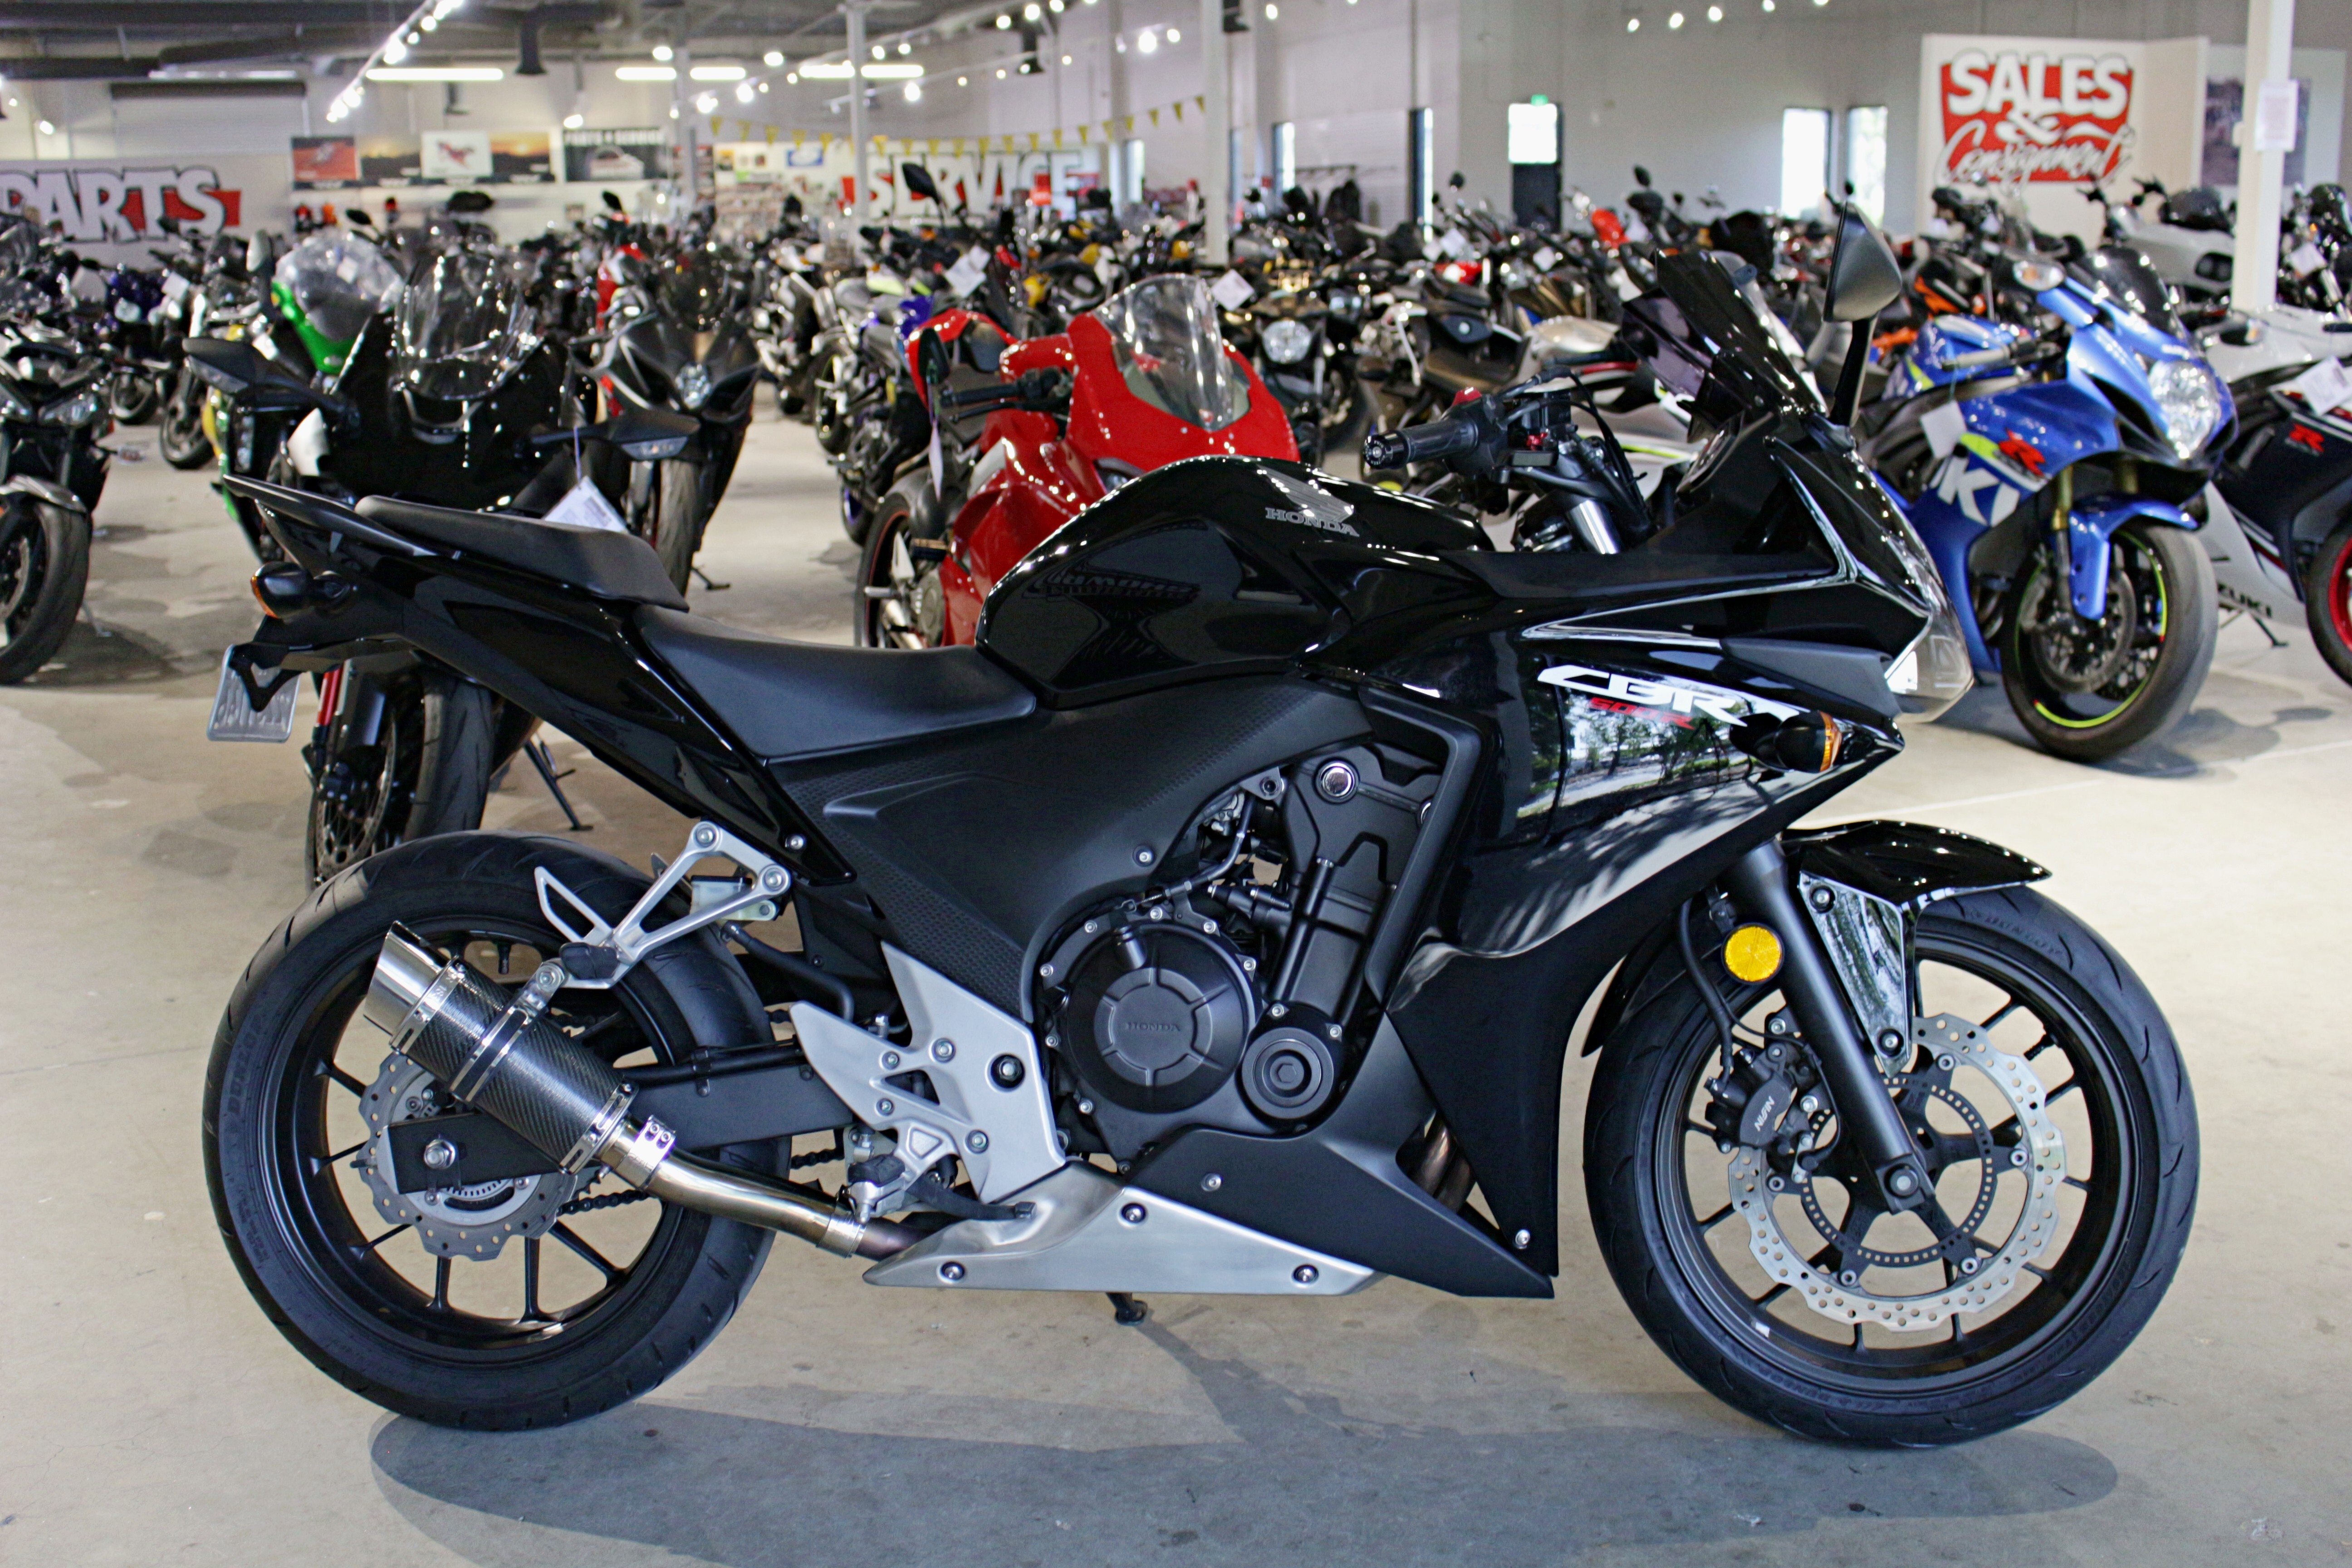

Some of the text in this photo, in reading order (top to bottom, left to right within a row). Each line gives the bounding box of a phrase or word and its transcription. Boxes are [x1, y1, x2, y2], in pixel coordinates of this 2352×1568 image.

[1948, 48, 2128, 119] SALES
[866, 153, 1082, 221] SERVICE
[1265, 507, 1360, 538] HONDA
[1537, 664, 1748, 727] CBR
[1589, 696, 1695, 730] 500R
[1127, 1021, 1181, 1033] HONDA
